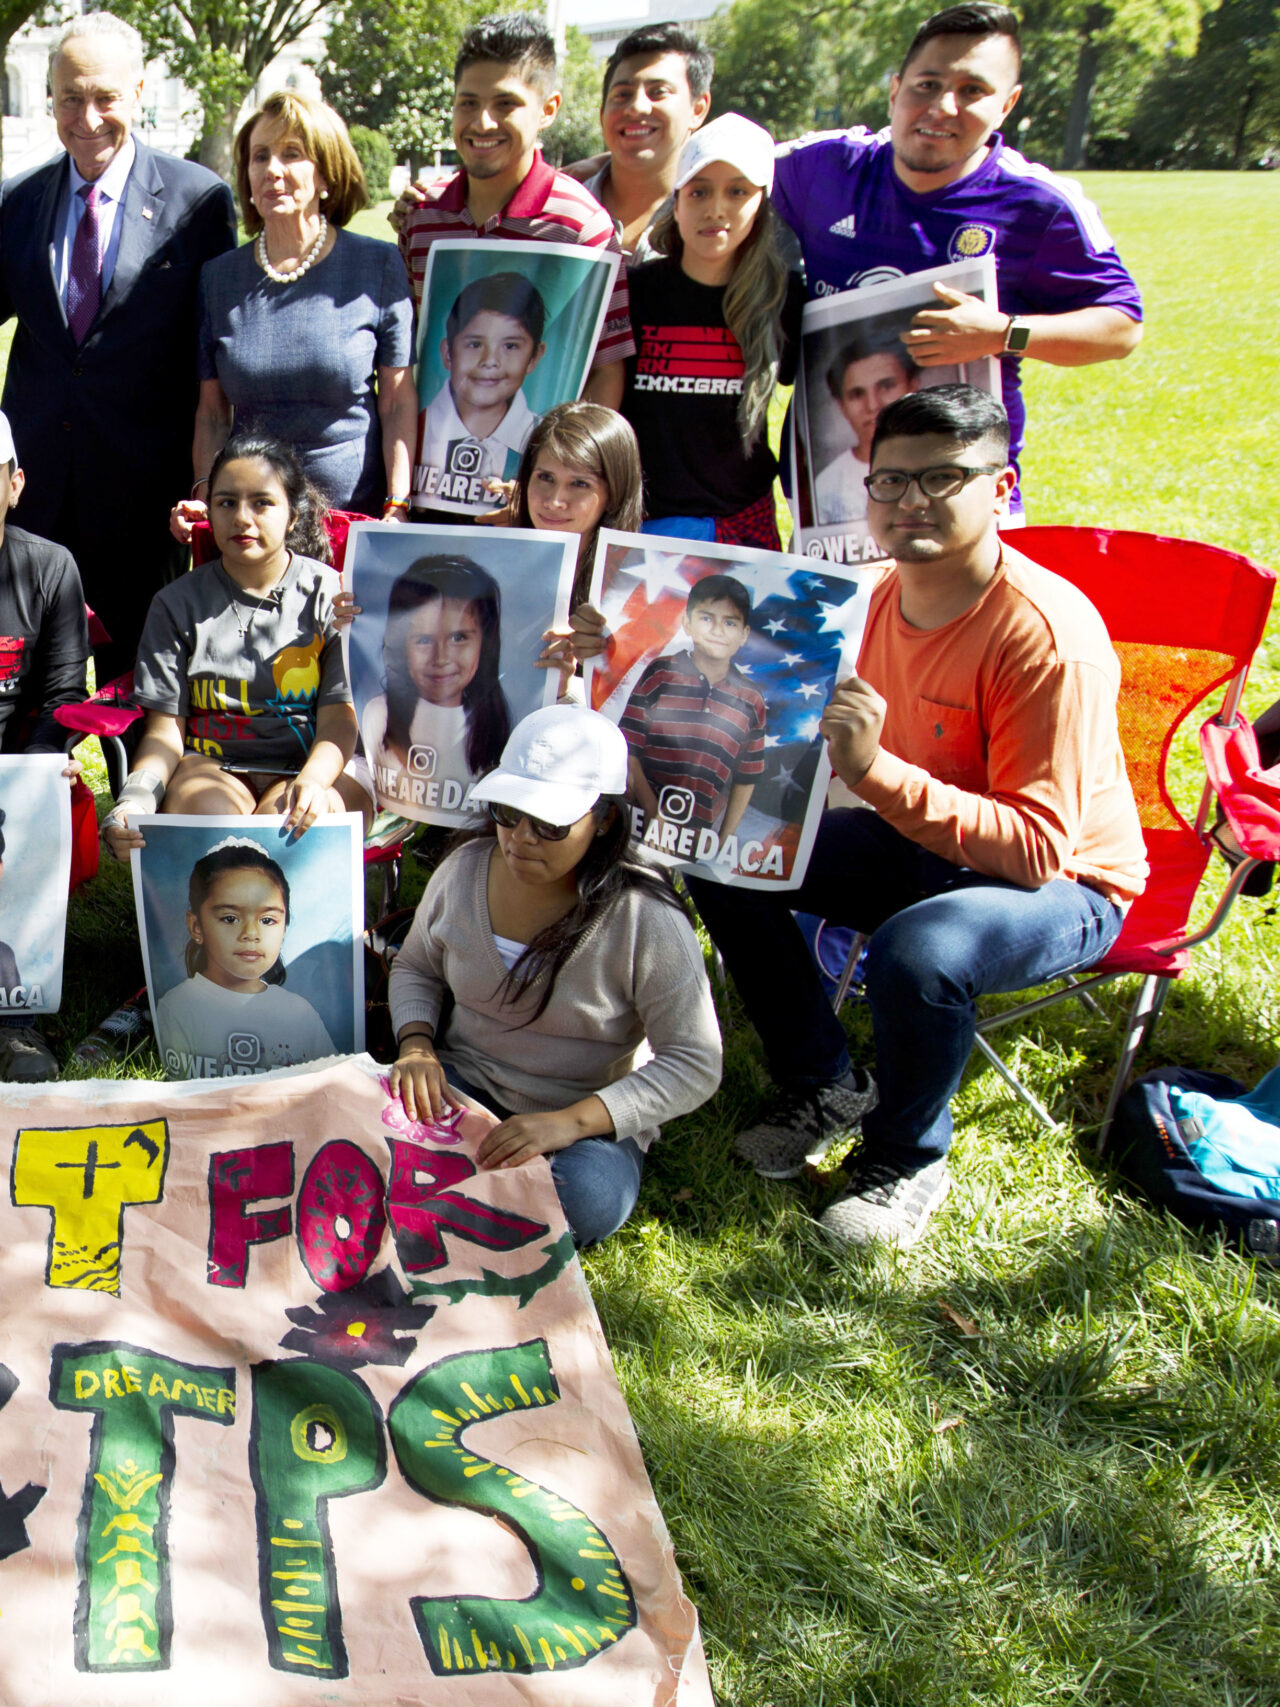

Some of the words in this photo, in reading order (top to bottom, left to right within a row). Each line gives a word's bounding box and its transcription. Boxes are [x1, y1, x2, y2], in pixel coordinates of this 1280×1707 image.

[633, 373, 745, 395] IMMIGRA
[206, 1138, 551, 1292] FOR
[73, 1365, 237, 1416] DREAMER
[49, 1338, 639, 1680] TPS
